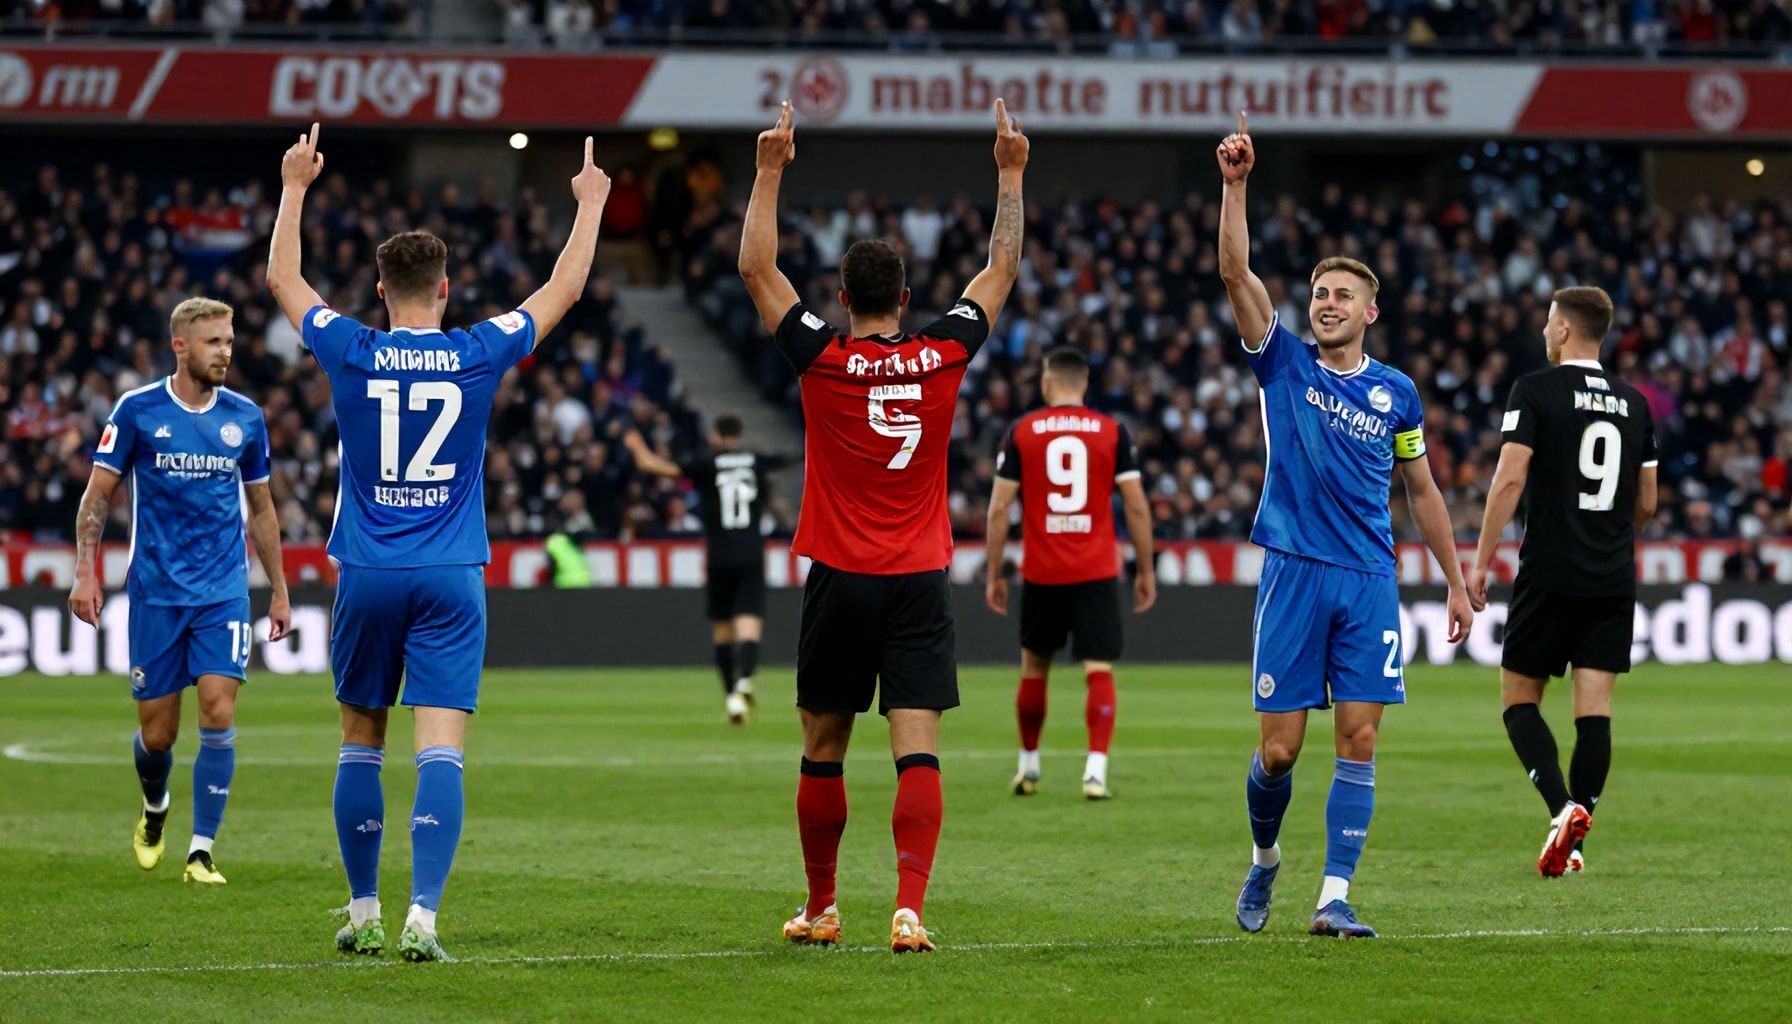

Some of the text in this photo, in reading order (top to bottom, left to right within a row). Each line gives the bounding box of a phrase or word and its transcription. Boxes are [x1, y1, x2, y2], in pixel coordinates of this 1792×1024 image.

[367, 379, 463, 482] 12
[1046, 435, 1089, 513] 9
[1578, 420, 1622, 511] 9
